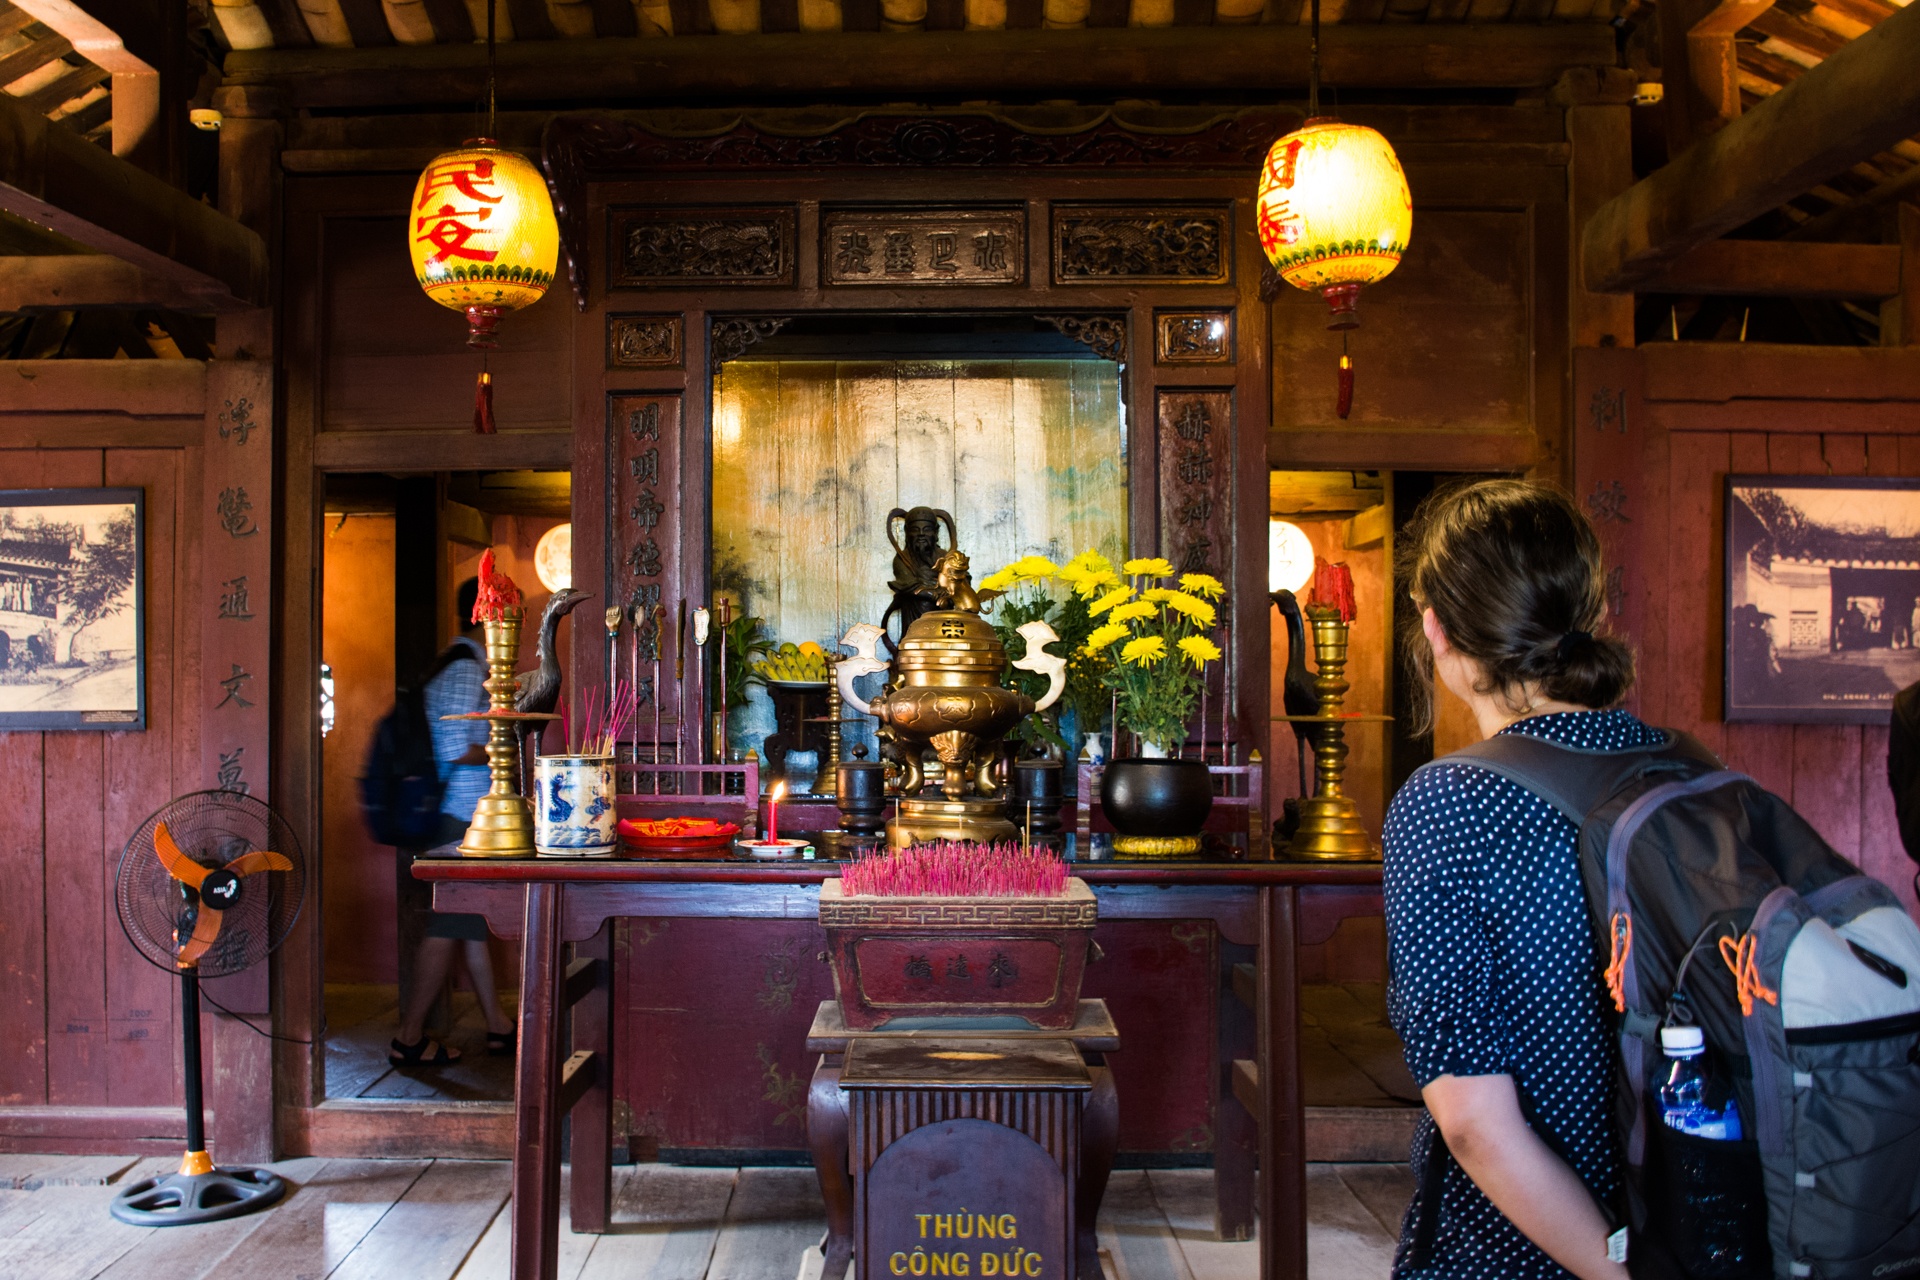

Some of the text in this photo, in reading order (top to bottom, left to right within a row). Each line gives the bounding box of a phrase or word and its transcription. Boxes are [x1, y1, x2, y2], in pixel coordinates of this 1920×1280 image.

[416, 158, 504, 269] 民安
[914, 1207, 1018, 1239] THÙNG
[889, 1245, 1043, 1277] CÔNG ĐỨC
